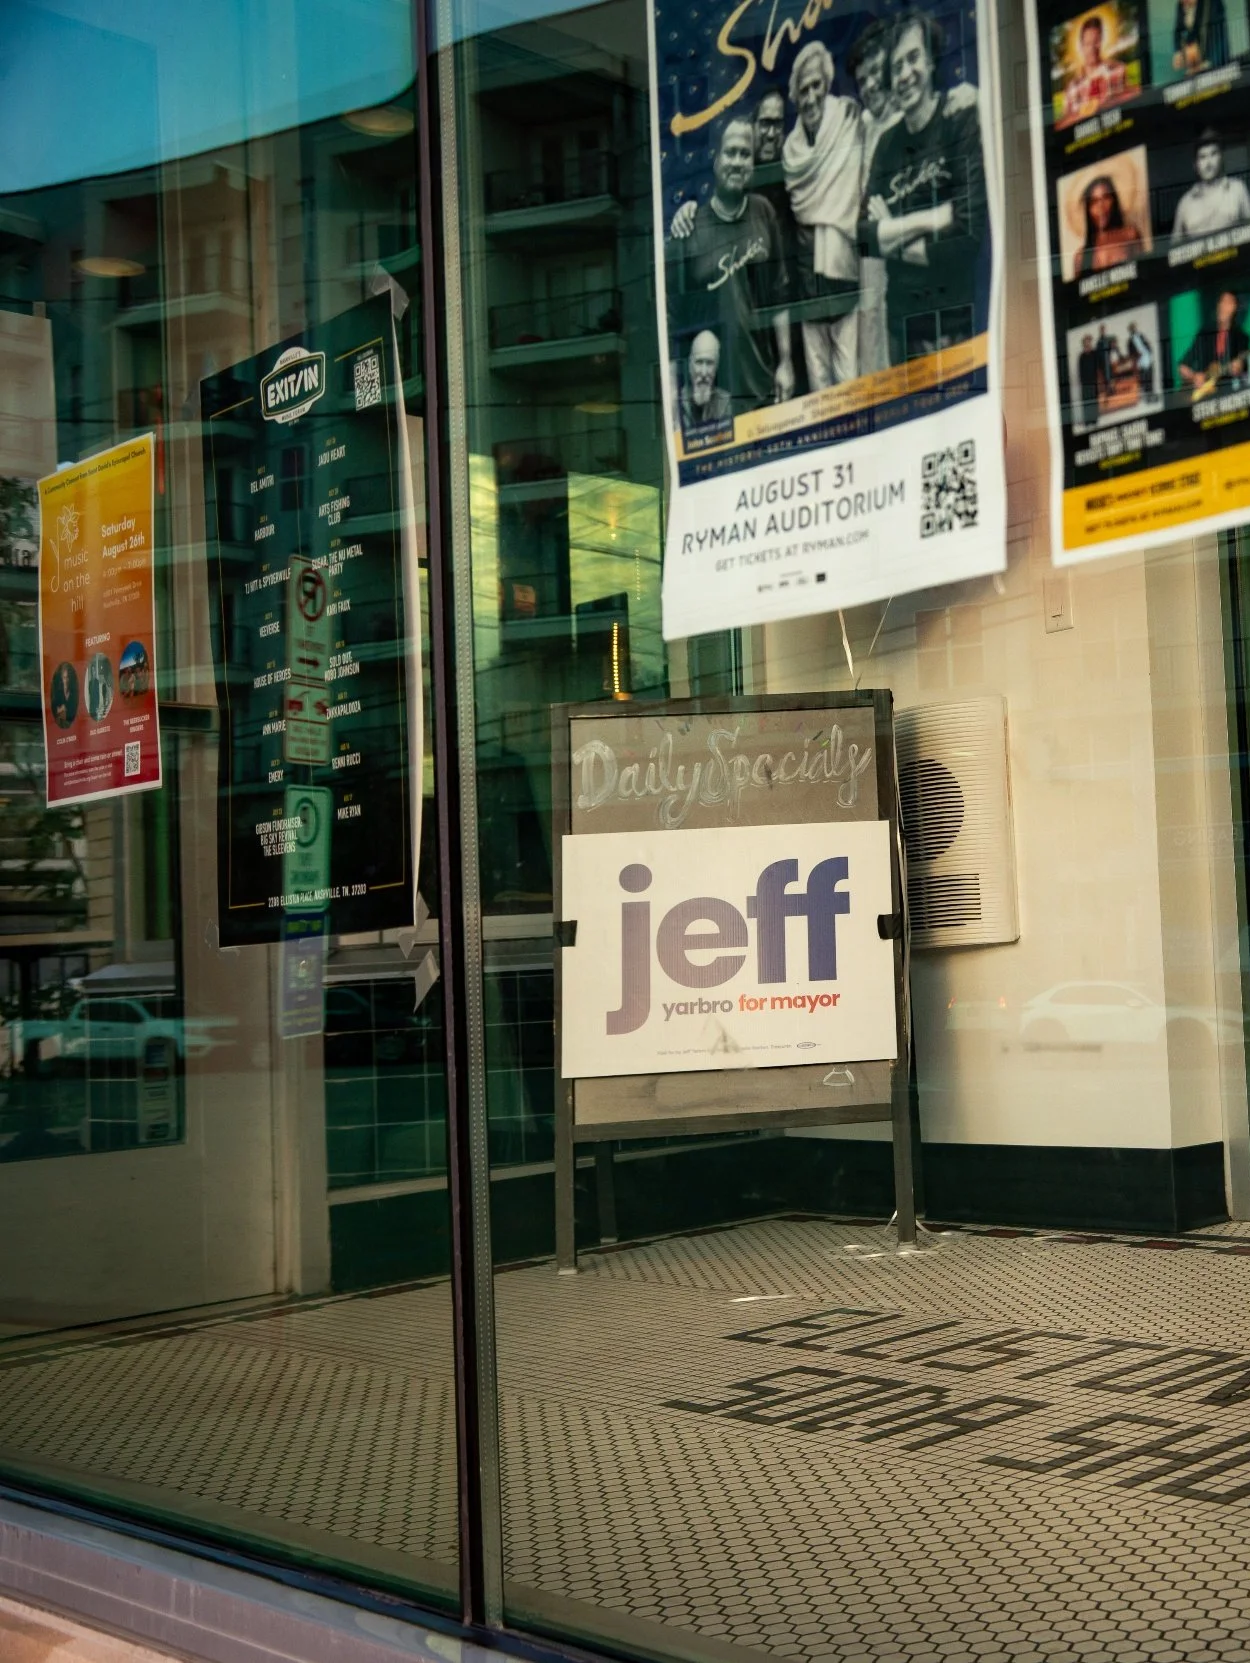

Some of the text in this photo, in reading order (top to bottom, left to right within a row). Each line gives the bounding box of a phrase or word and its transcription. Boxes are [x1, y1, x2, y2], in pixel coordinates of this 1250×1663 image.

[267, 364, 319, 408] EXIT/IN
[331, 445, 346, 461] HEART
[735, 461, 855, 512] AUGUST 31
[318, 495, 351, 517] ARTS FISHING
[328, 512, 341, 526] CLUB
[682, 480, 906, 555] RYMAN AUDITORIUM
[101, 515, 136, 538] Saturday
[102, 531, 145, 559] August 26th
[346, 544, 363, 560] METAL
[64, 550, 89, 570] music
[328, 562, 344, 577] PARTY
[63, 571, 91, 593] on the
[71, 596, 84, 613] hill
[85, 632, 111, 648] FEATURING
[329, 655, 342, 668] SOLD
[273, 667, 292, 684] HEROES
[337, 662, 360, 679] JOHNSON
[268, 769, 284, 784] EMERY
[572, 724, 872, 829] Daily Specials
[337, 807, 349, 821] MIKE
[255, 820, 272, 835] GIBSON
[260, 829, 298, 847] BIG SKY REVIVAL
[263, 845, 272, 858] THE
[606, 856, 850, 1036] jeff
[662, 992, 841, 1021] yarbro for mayor
[662, 1366, 1054, 1452] SODA
